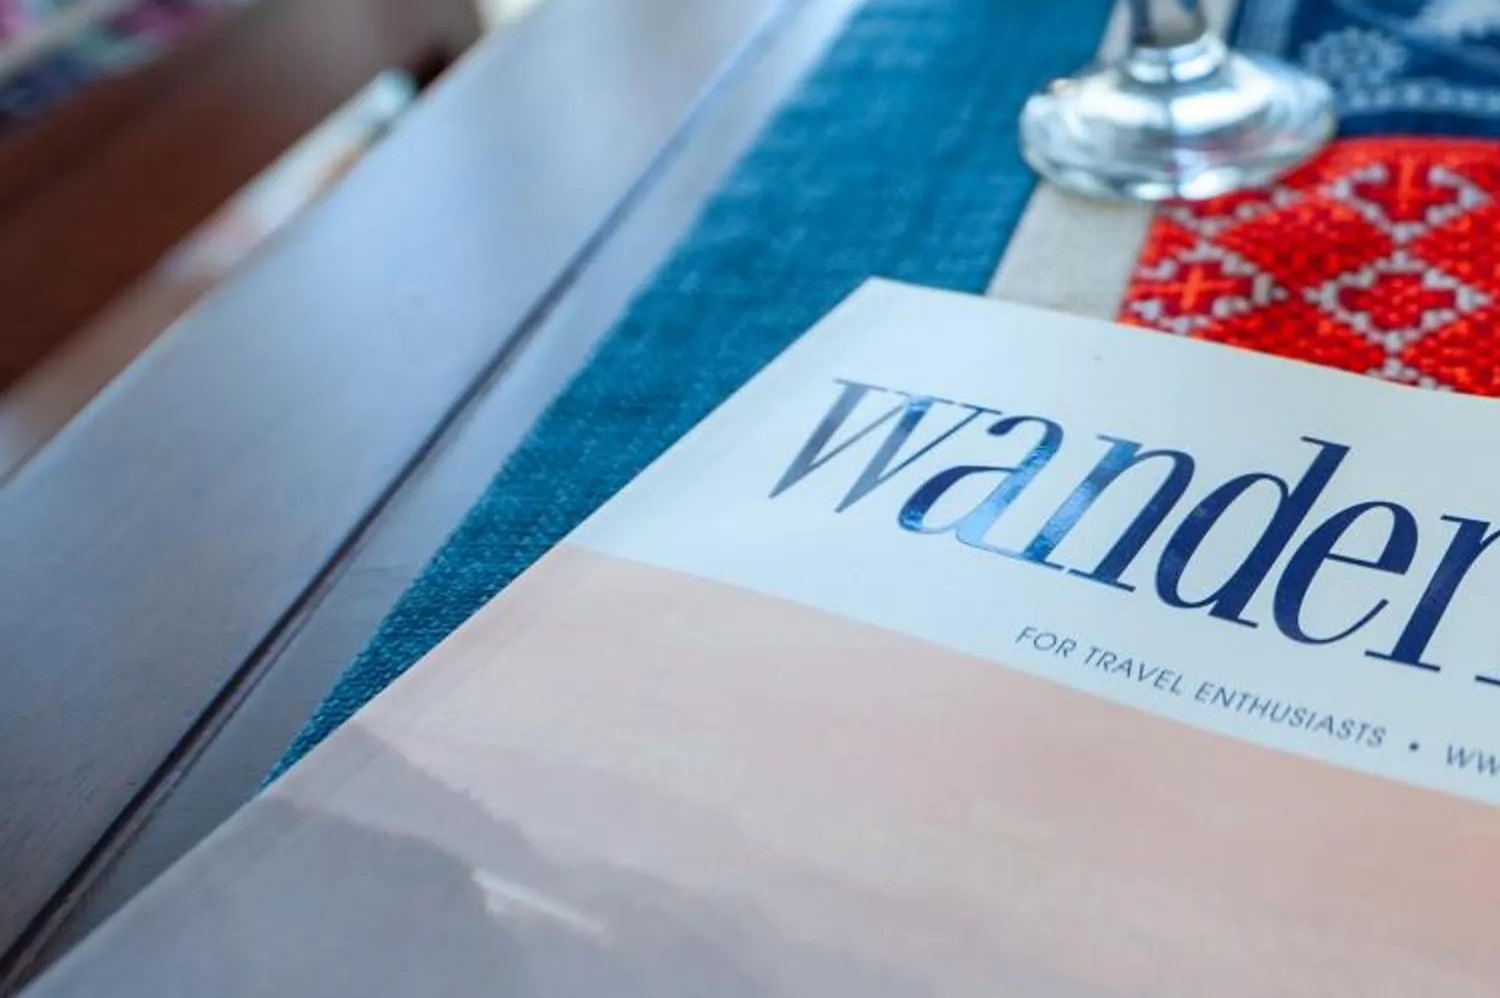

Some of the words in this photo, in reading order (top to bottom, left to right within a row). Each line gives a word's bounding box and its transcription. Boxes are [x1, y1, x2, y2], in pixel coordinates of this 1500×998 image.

[1015, 626, 1078, 659] FOR
[1084, 647, 1184, 697] TRAVEL
[1195, 682, 1387, 749] ENTHUSIASTS
